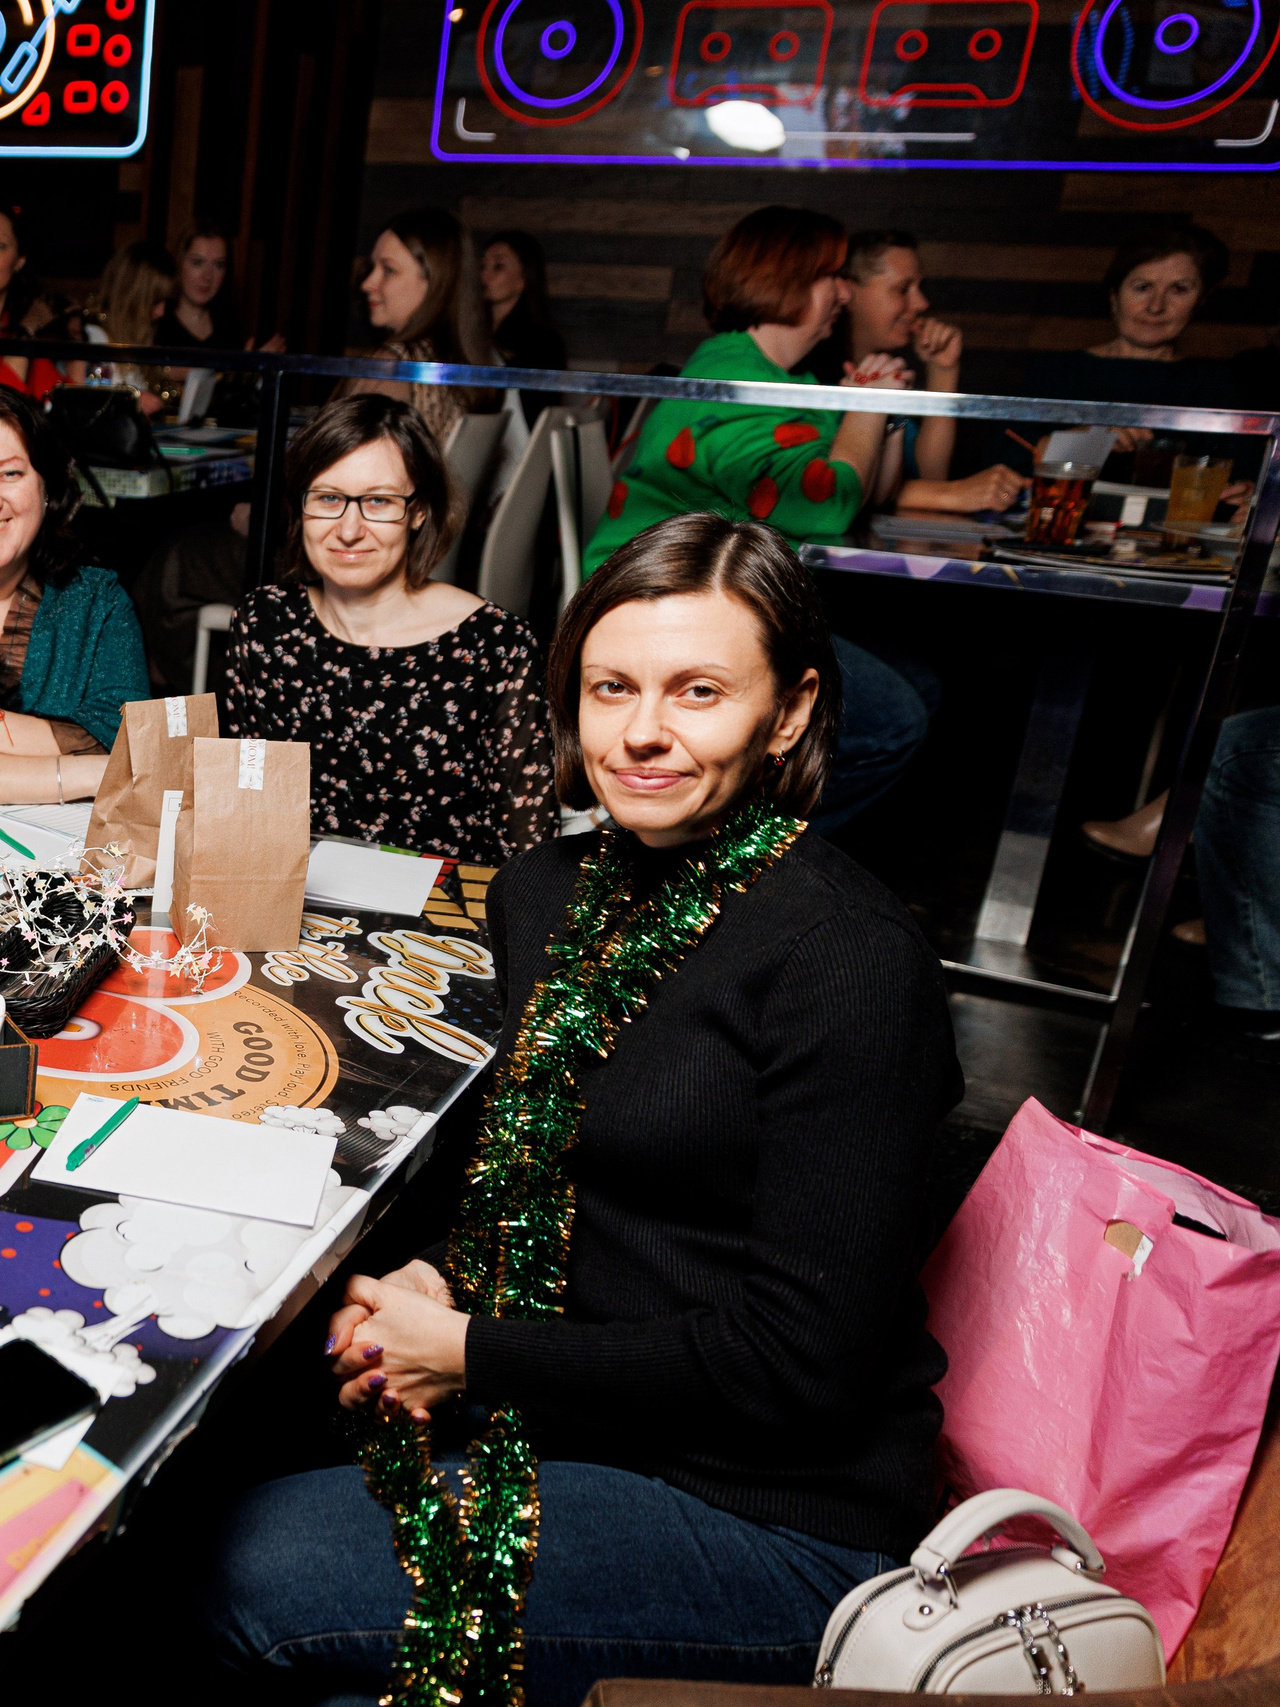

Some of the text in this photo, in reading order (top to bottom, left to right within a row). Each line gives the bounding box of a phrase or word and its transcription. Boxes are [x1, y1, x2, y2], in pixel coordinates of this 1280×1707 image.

[232, 990, 282, 1024] Recorded
[349, 930, 493, 1060] Back
[283, 1020, 303, 1042] with
[110, 1031, 226, 1092] WITH GOOD FRIENDS
[293, 1039, 306, 1061] love.
[139, 1021, 275, 1111] GOOD TIM
[291, 1063, 310, 1083] Play
[232, 1099, 280, 1120] Stereo
